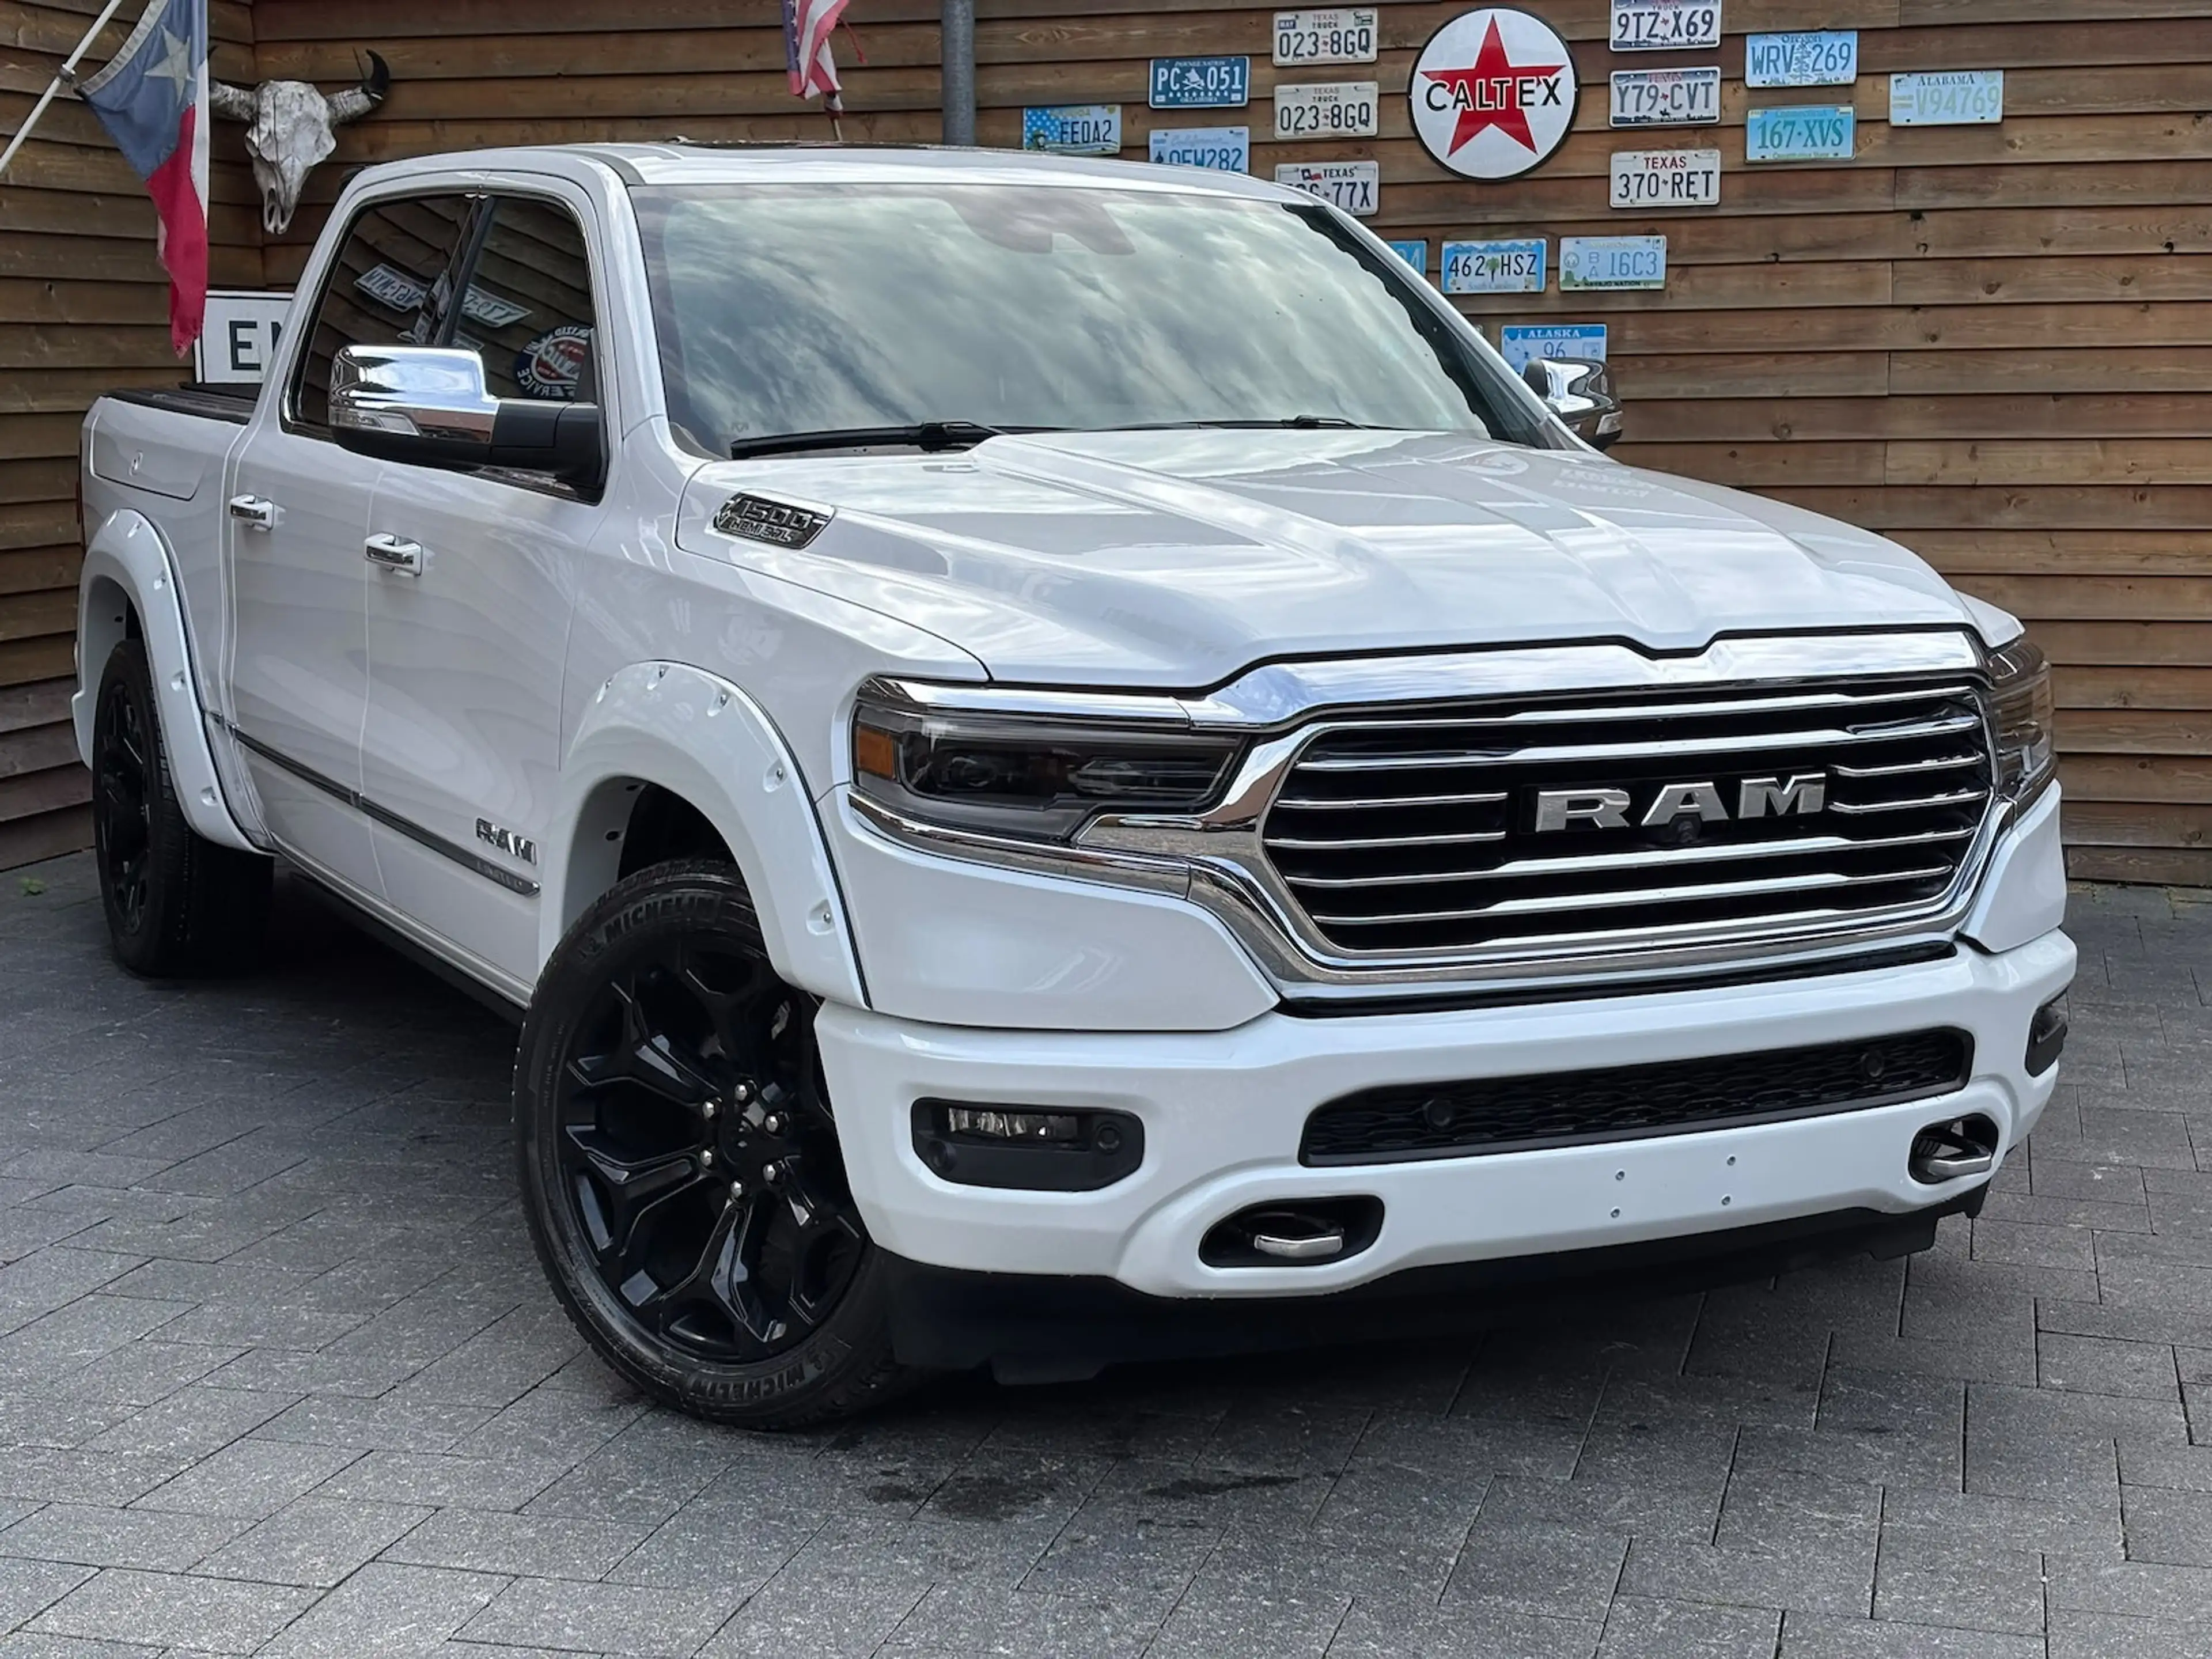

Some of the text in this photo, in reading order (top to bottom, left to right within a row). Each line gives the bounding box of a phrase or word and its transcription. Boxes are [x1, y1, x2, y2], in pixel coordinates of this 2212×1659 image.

[1313, 13, 1339, 21] TEXAS
[1157, 67, 1181, 91] PC
[1313, 86, 1339, 94] TEXAS
[1917, 73, 1976, 86] ALABAMA
[1424, 76, 1563, 112] CALTEX
[1323, 168, 1355, 179] TEXAS
[1643, 156, 1687, 169] TEXAS
[1618, 170, 1714, 199] 370 RET
[1448, 255, 1486, 278] 462
[1501, 253, 1537, 276] HSZ
[1608, 251, 1657, 276] 16C3
[1528, 329, 1581, 338] ALASKA
[740, 499, 813, 529] 1500
[1535, 772, 1827, 833] RAM
[476, 817, 537, 866] RAM
[604, 894, 718, 944] MICHELIN
